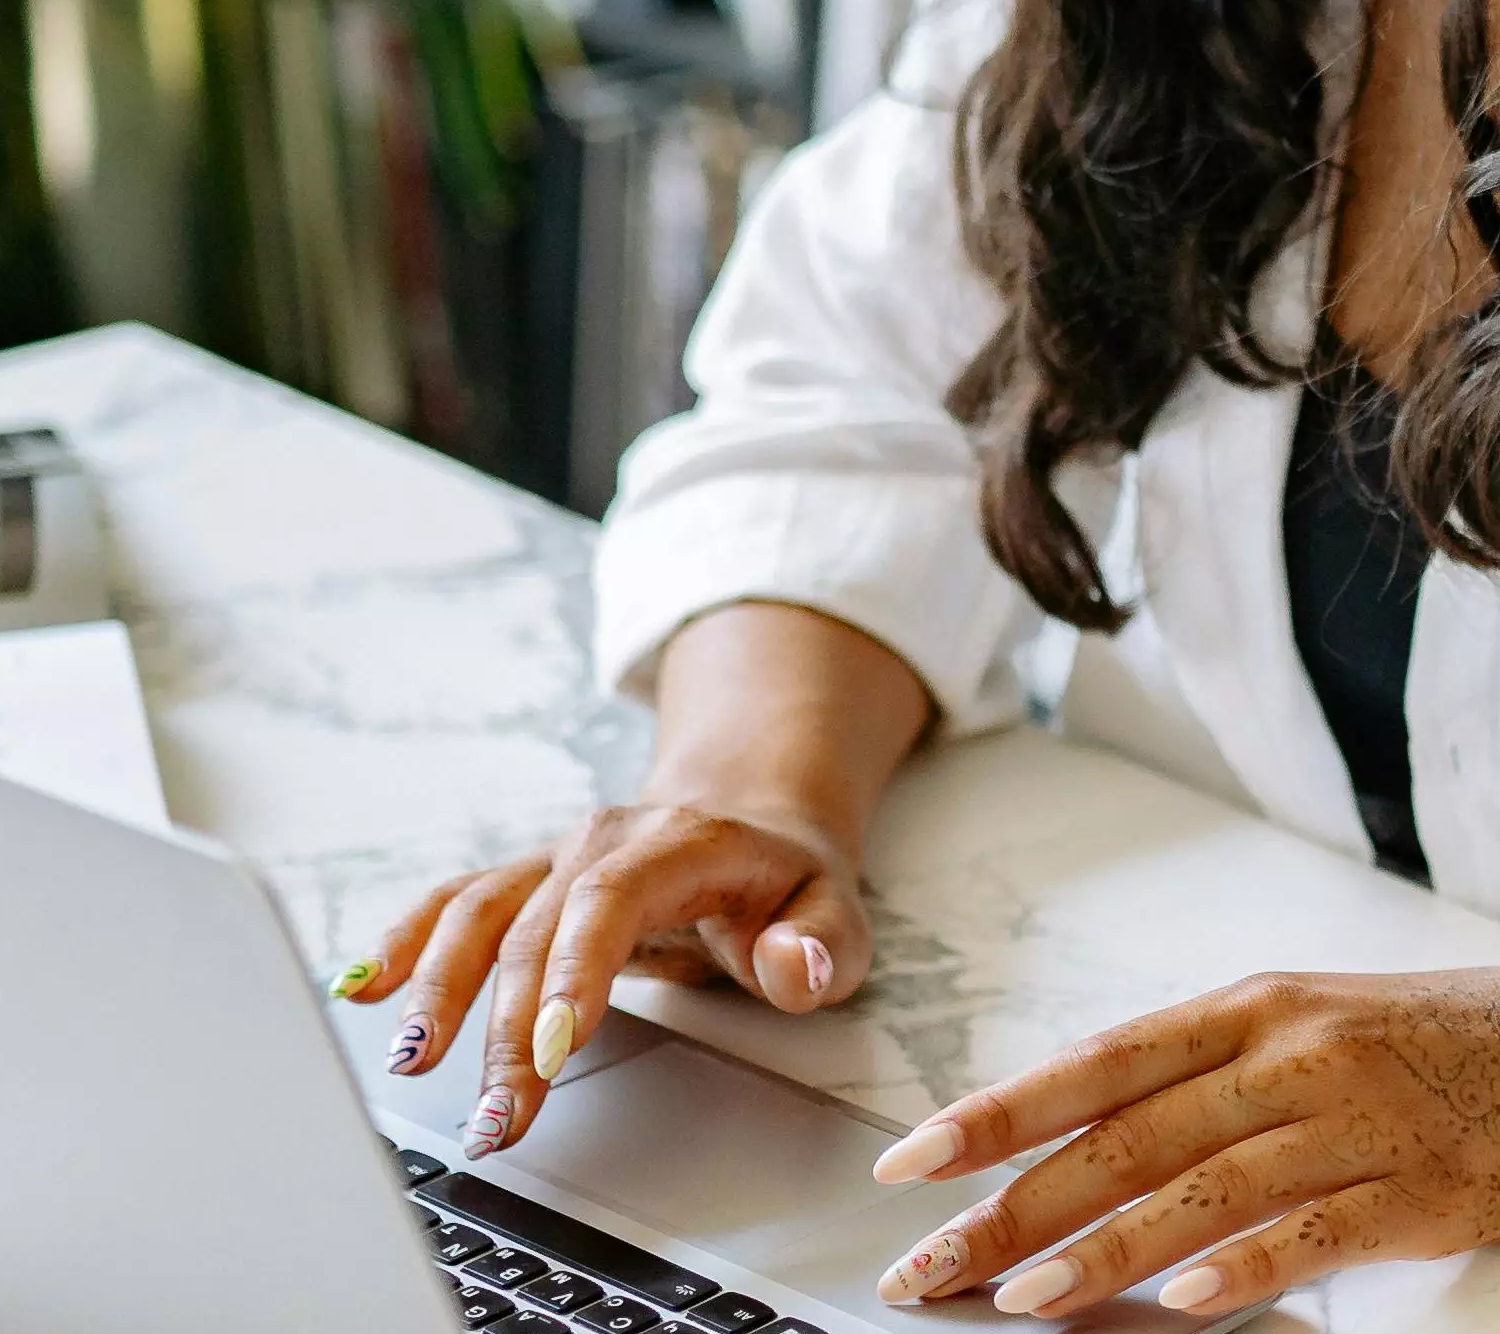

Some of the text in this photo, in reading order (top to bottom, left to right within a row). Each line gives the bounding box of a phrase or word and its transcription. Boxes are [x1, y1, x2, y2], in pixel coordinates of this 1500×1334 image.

[441, 1243, 469, 1257] N
[499, 1268, 524, 1281] B
[550, 1291, 574, 1305] V
[464, 1306, 488, 1319] G
[733, 1309, 756, 1321] Alt
[609, 1317, 633, 1329] C
